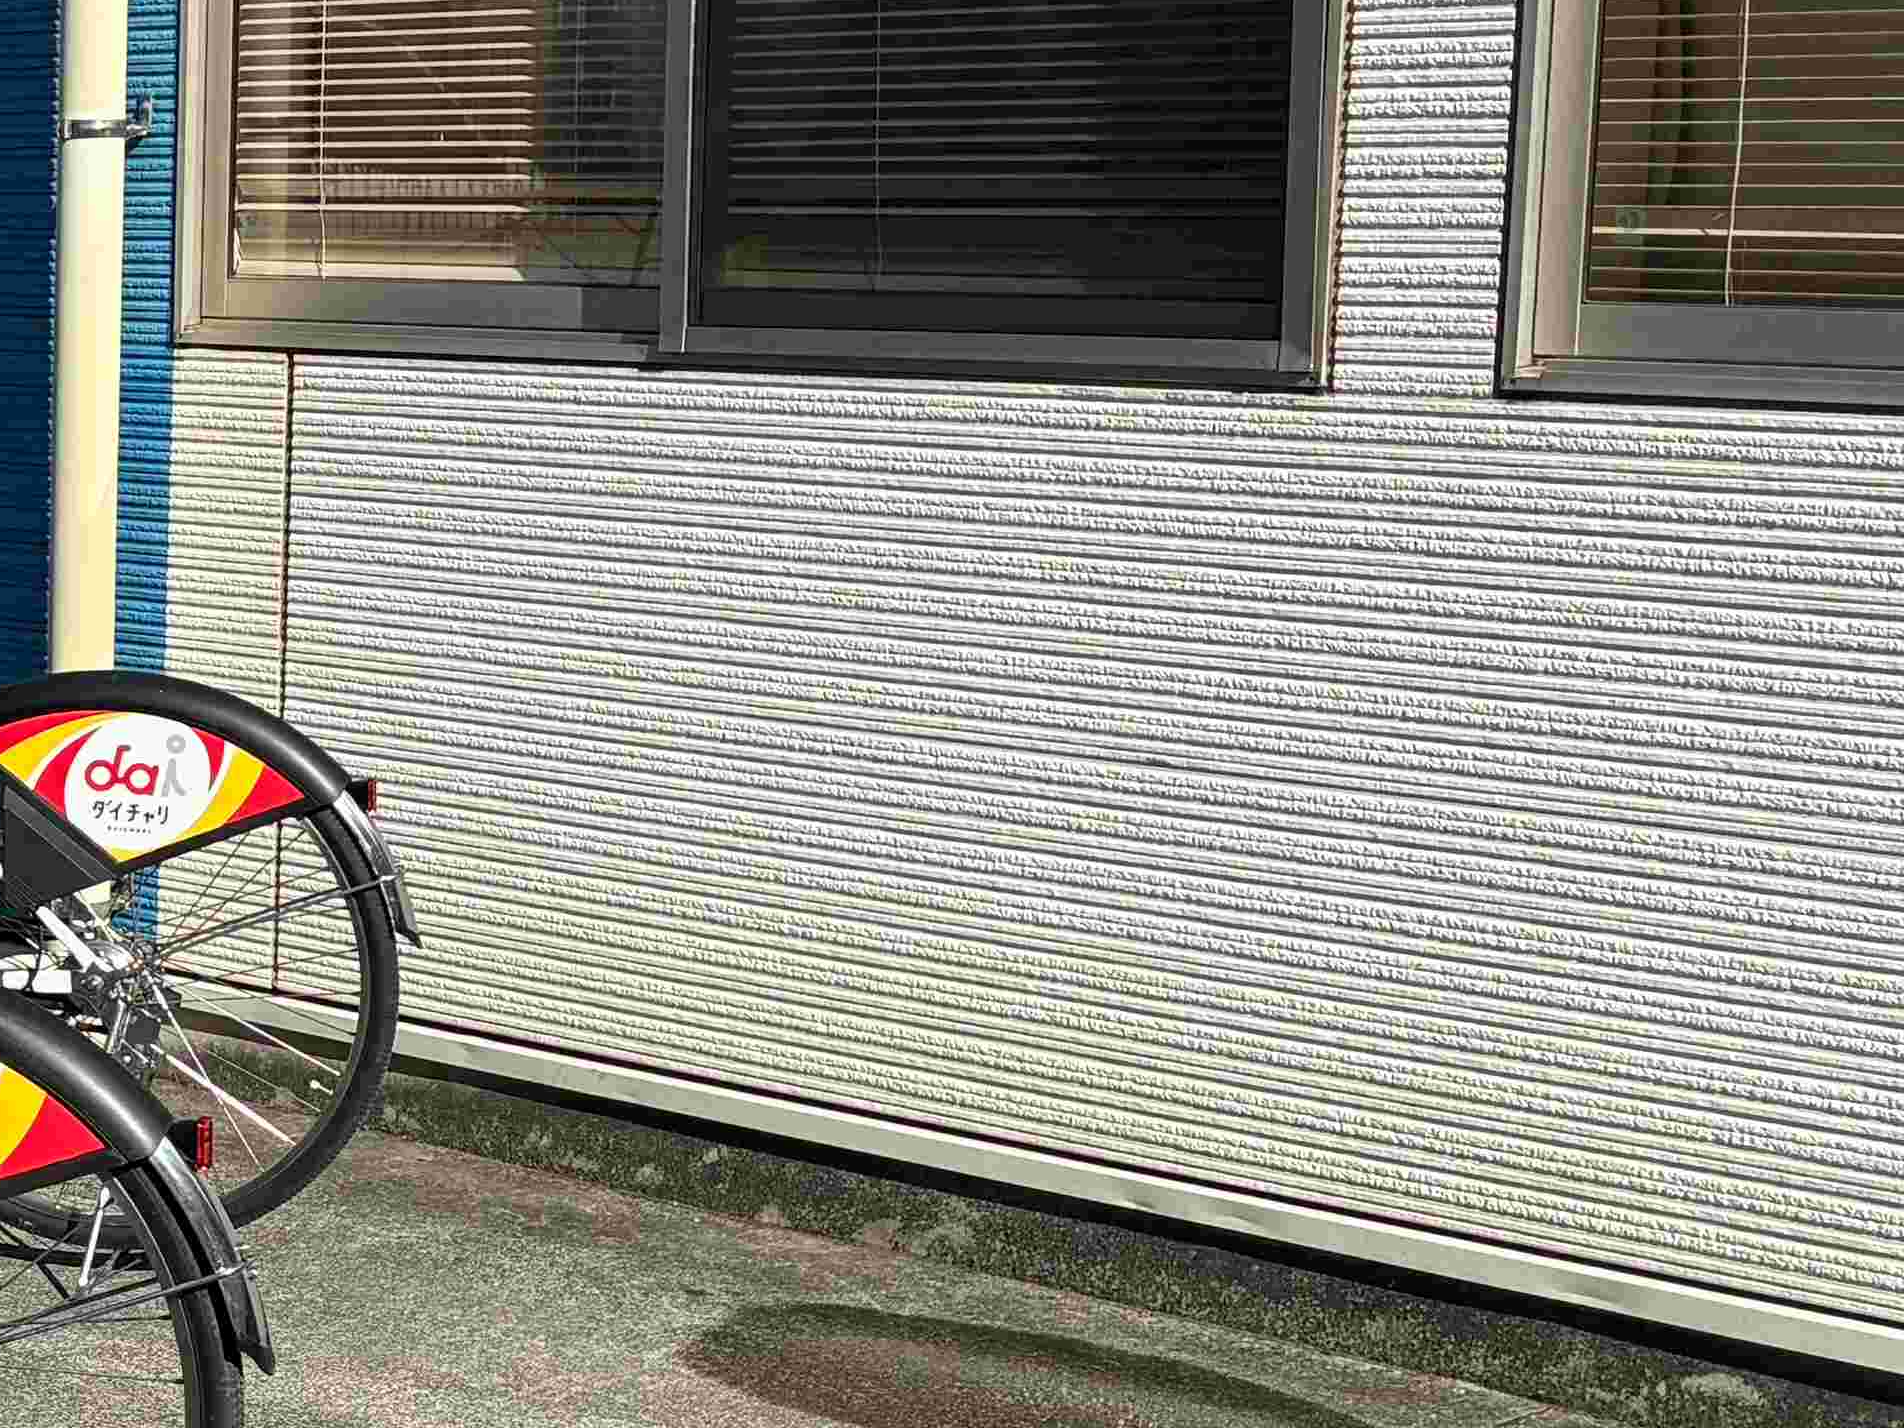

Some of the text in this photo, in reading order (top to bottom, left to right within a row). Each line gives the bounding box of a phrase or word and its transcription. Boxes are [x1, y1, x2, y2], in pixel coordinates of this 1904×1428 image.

[92, 799, 169, 825] ダイチャリ
